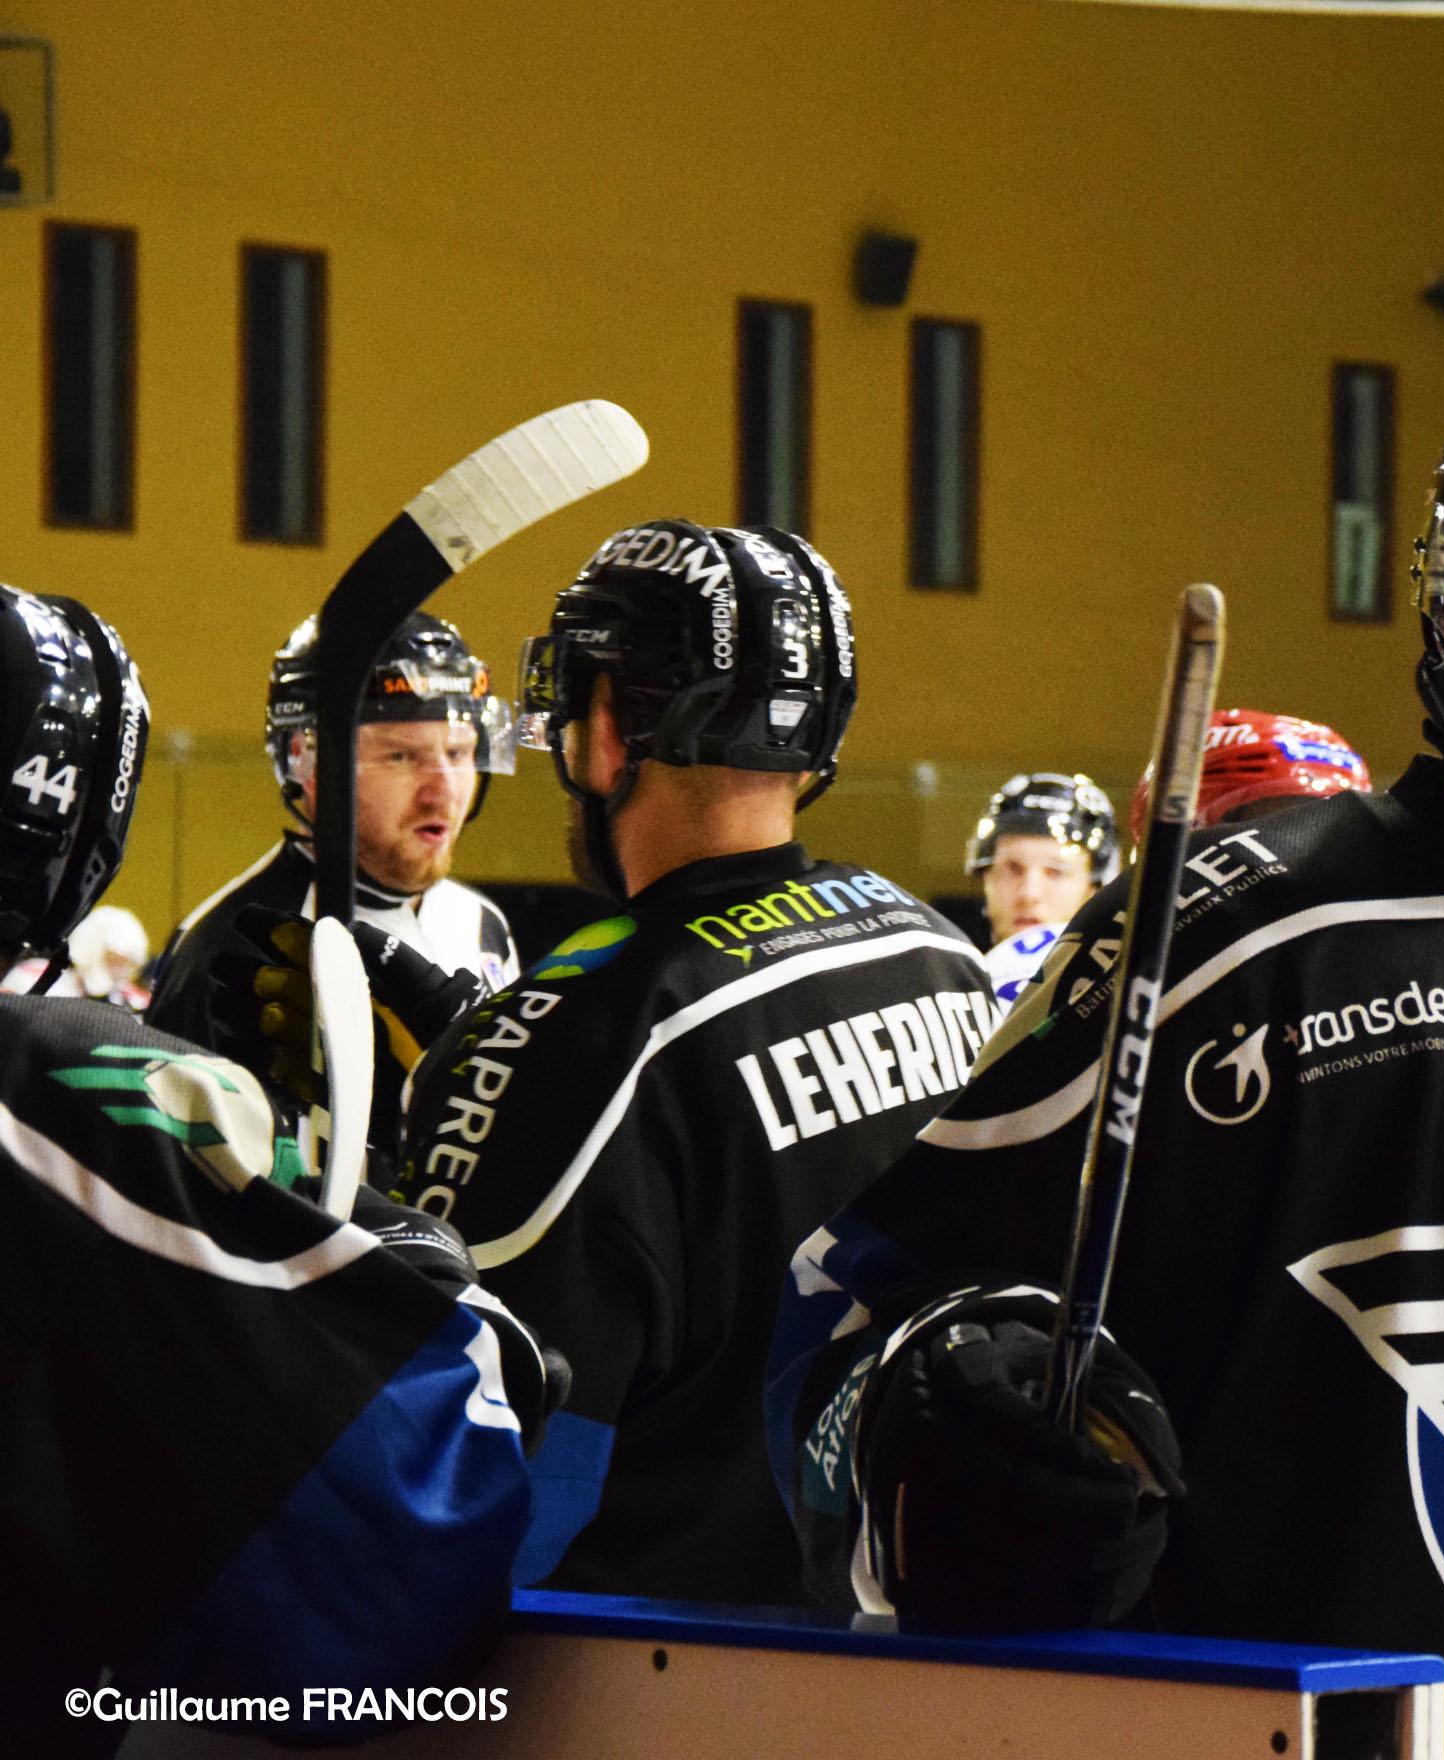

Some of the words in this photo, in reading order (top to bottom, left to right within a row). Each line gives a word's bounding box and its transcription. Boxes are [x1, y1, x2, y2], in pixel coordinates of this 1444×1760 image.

[712, 588, 733, 669] COGEDIM
[781, 638, 810, 679] 3
[11, 755, 79, 815] 44
[685, 871, 915, 948] nantnet
[1106, 976, 1161, 1146] CCM
[415, 990, 563, 1221] PAPREC
